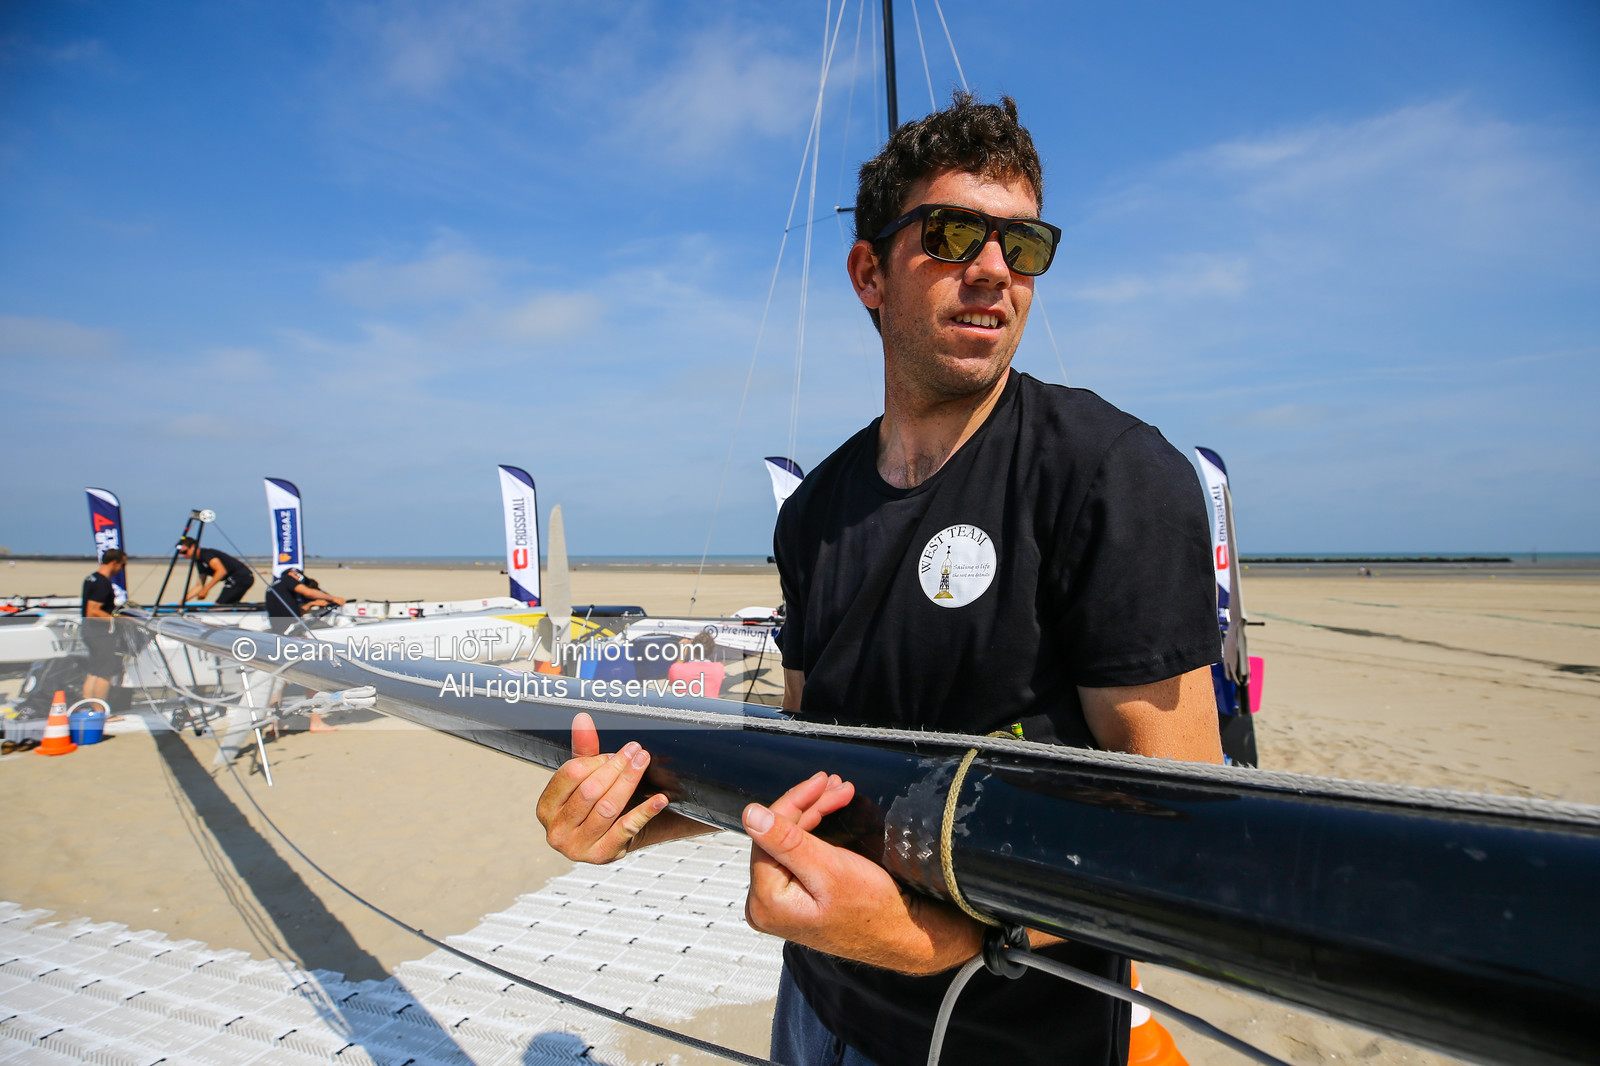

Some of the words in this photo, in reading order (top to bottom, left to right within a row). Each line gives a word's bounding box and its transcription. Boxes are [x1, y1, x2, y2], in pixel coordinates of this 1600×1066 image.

[280, 511, 293, 552] FINAGAZ
[512, 497, 528, 547] CROSSCALL
[921, 533, 943, 574] WEST
[947, 526, 988, 546] TEAM
[953, 564, 974, 573] Sailing
[466, 626, 512, 647] WEST
[721, 626, 767, 639] Premium
